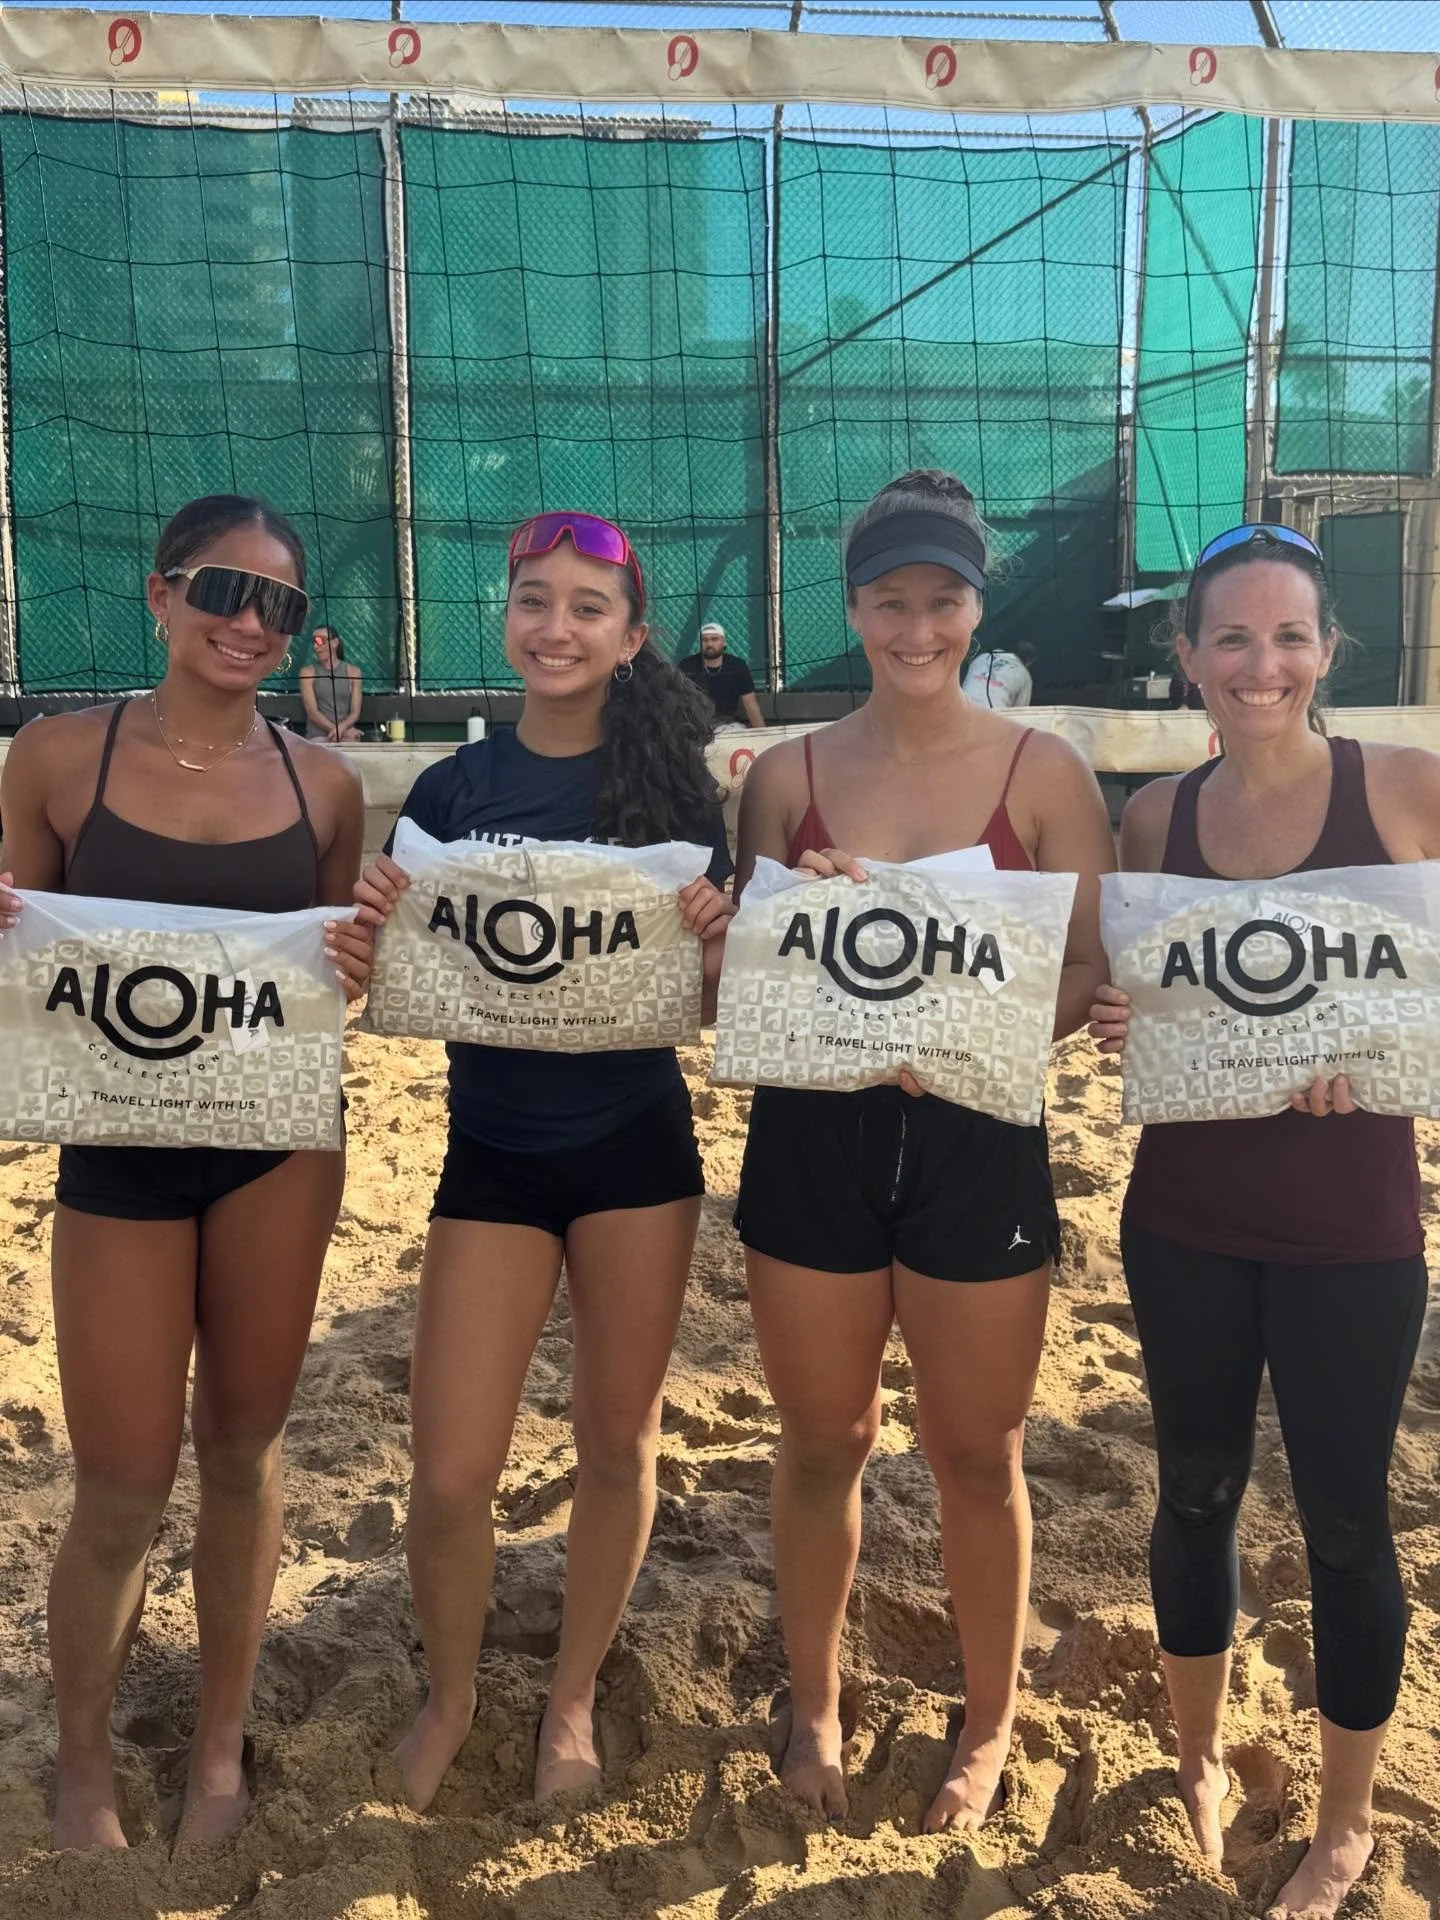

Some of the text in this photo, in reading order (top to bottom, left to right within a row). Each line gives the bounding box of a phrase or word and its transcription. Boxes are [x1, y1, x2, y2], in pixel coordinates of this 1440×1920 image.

[427, 894, 640, 984] ALOHA
[778, 906, 1005, 1001] ALOHA
[463, 965, 581, 1000] COLLECTION
[1160, 919, 1407, 1017] ALOHA
[45, 963, 285, 1061] ALOHA
[469, 1006, 617, 1027] TRAVEL LIGHT WITH US
[816, 986, 939, 1021] COLLECTION
[1208, 1002, 1338, 1037] COLLECTION
[88, 1043, 220, 1079] COLLECTION
[817, 1035, 972, 1062] TRAVEL LIGHT WITH US
[1219, 1050, 1385, 1070] TRAVEL LIGHT WITH US
[92, 1090, 256, 1111] TRAVEL LIGHT WITH US
